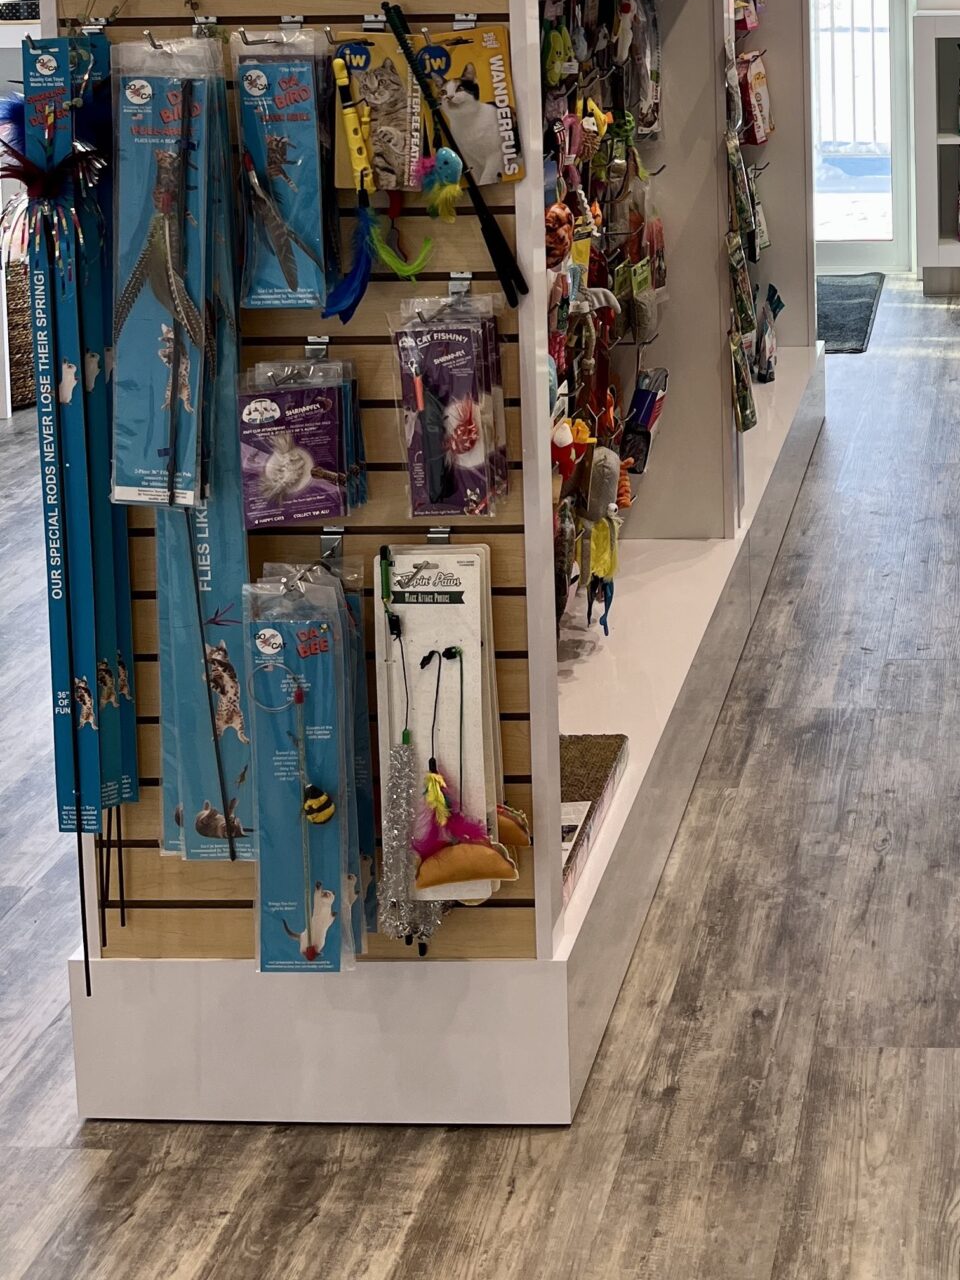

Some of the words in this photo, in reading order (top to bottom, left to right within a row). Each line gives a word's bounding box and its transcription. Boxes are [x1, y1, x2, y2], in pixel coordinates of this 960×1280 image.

[343, 47, 367, 67] jw
[421, 50, 446, 74] jw
[124, 83, 137, 91] GO
[140, 92, 156, 100] CAT
[257, 83, 272, 91] CAT
[278, 74, 299, 91] DA
[274, 86, 312, 110] BIRD
[489, 54, 519, 175] WANDERFULS
[33, 269, 48, 328] SPRING!
[36, 330, 51, 372] THEIR
[416, 334, 432, 346] CAT
[39, 374, 53, 413] LOSE
[42, 415, 56, 463] NEVER
[44, 465, 58, 505] RODS
[195, 499, 209, 538] LIKE
[47, 507, 61, 567] SPECIAL
[197, 543, 212, 592] FLIES
[432, 571, 462, 588] Paws
[50, 569, 64, 600] OUR
[271, 642, 287, 650] CAT
[296, 626, 320, 642] DA
[296, 638, 329, 660] BEE
[57, 691, 70, 699] 36"
